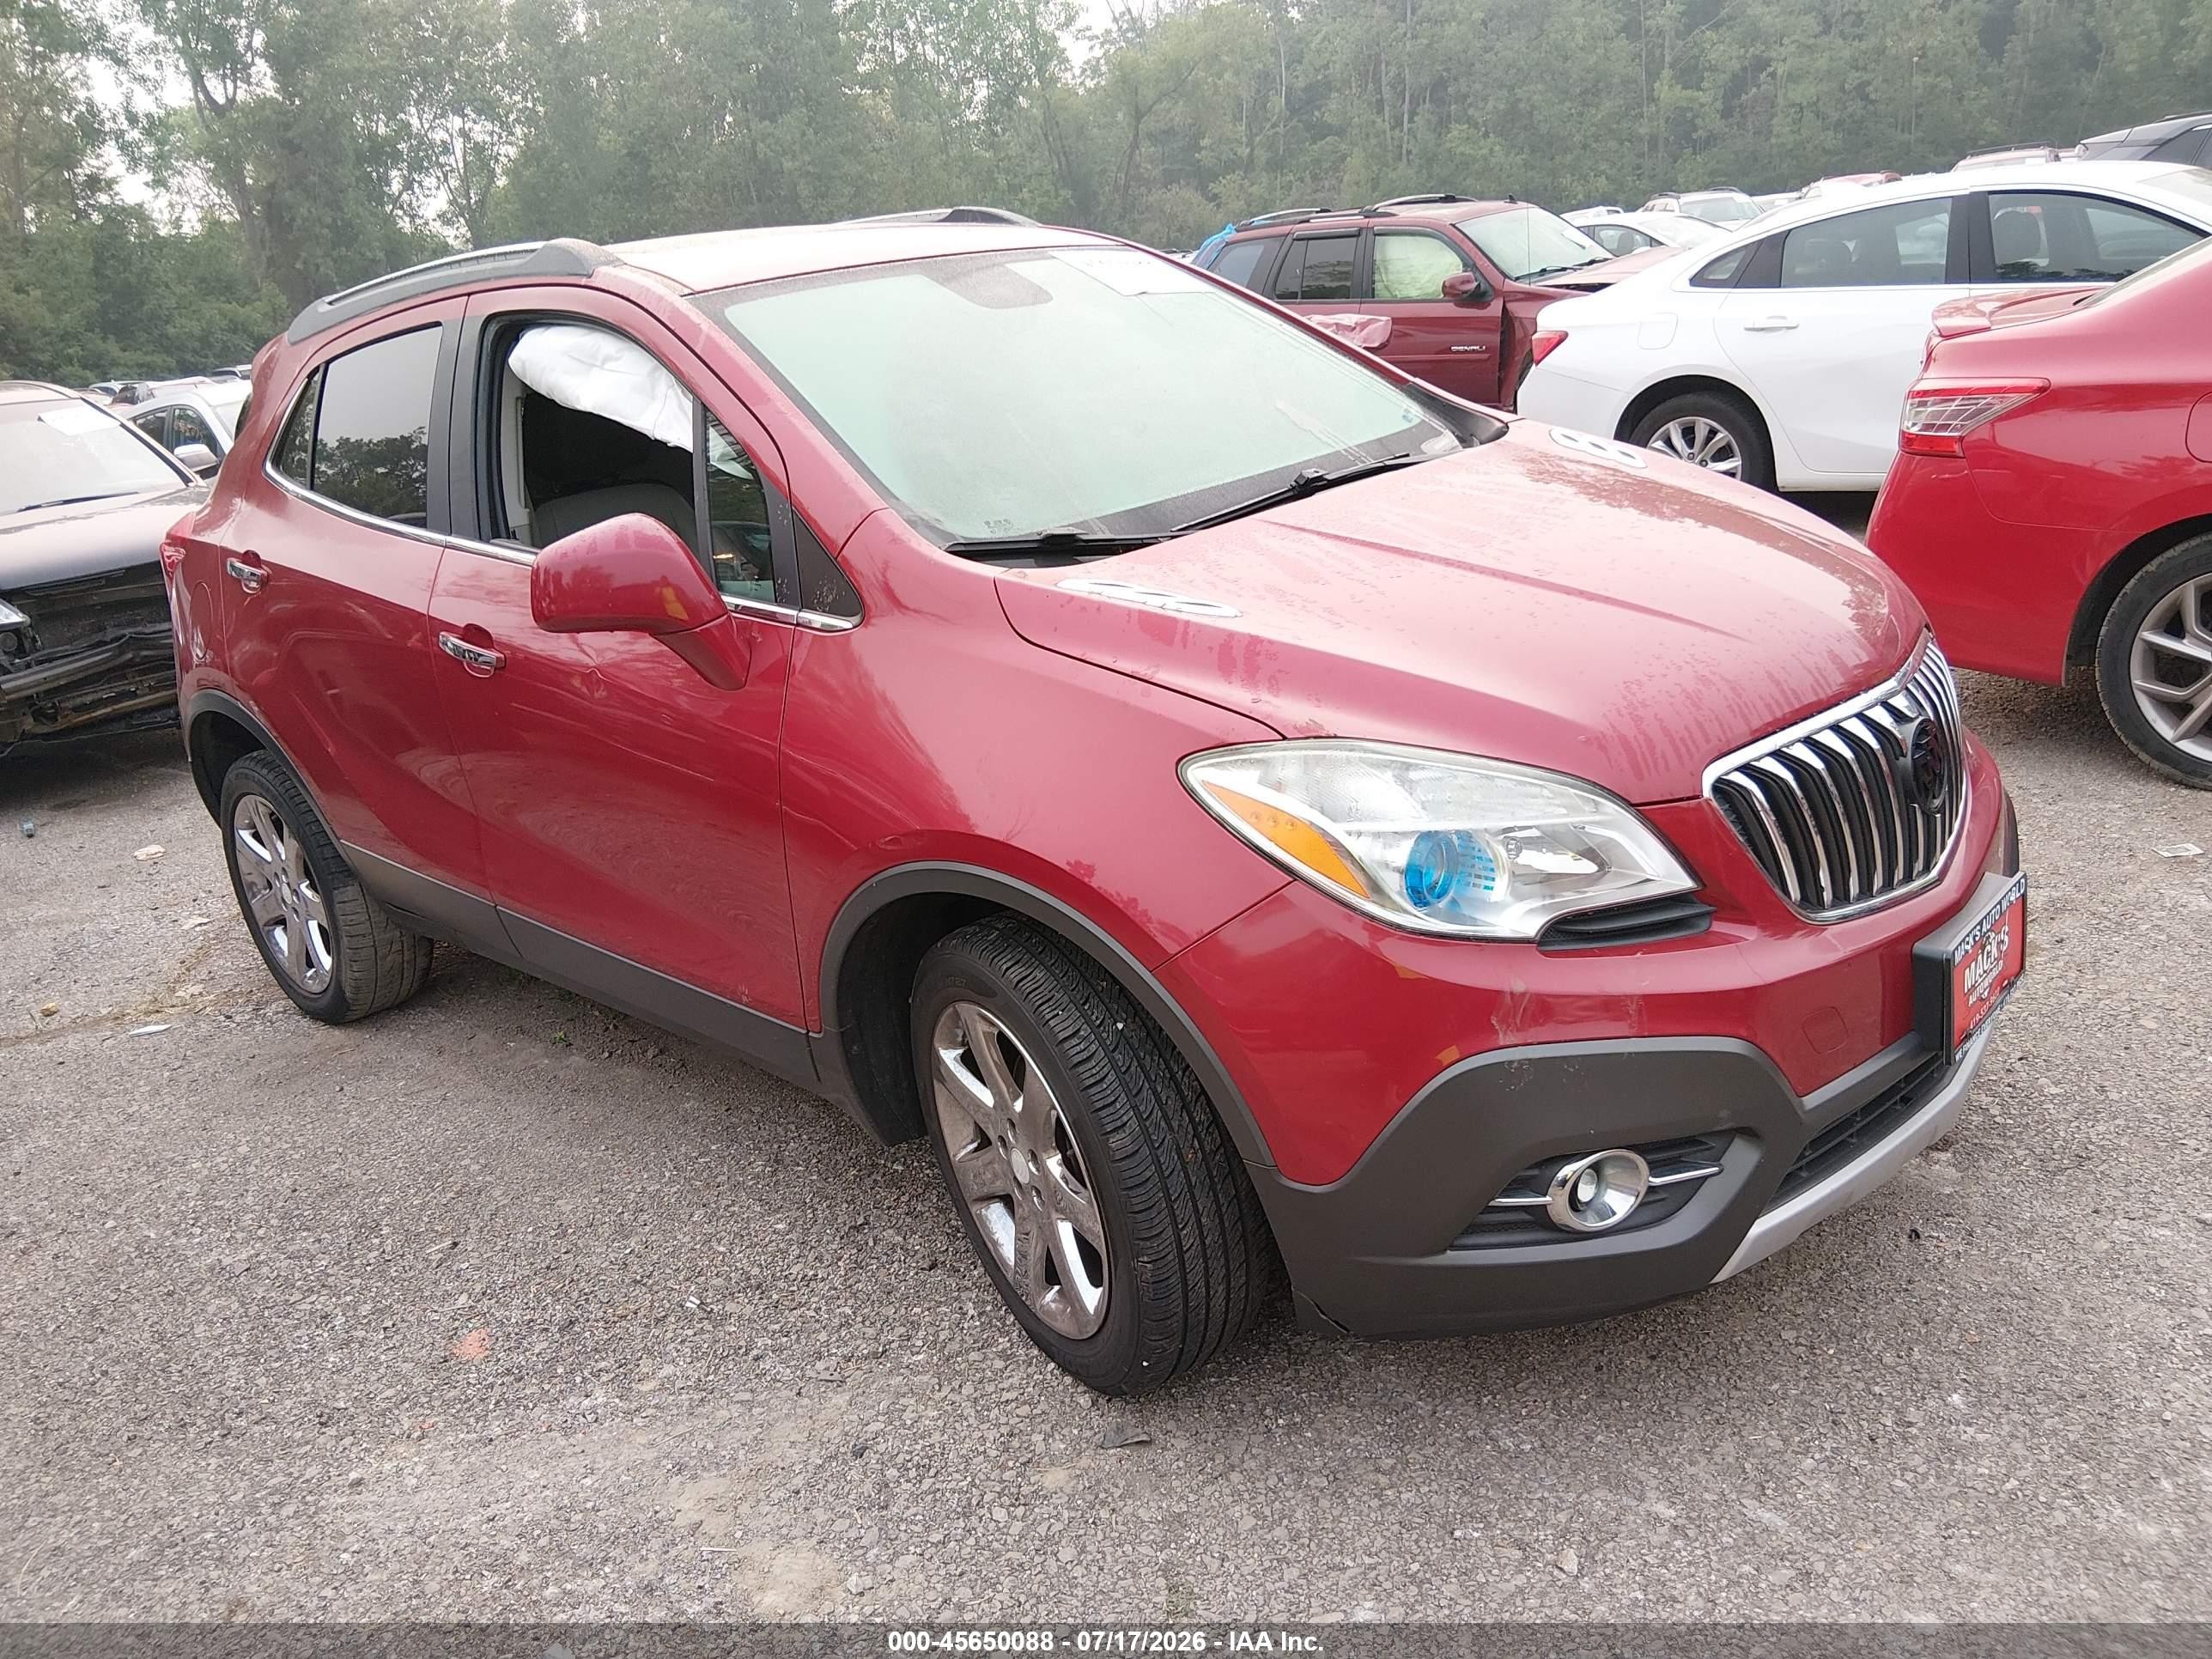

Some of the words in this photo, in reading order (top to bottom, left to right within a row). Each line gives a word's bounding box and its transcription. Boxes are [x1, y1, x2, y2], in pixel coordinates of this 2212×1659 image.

[1954, 926, 1980, 966] MACK'S
[1982, 906, 2001, 935] AUTO
[2002, 878, 2025, 912] WORLD
[1964, 926, 2009, 994] MACK'S
